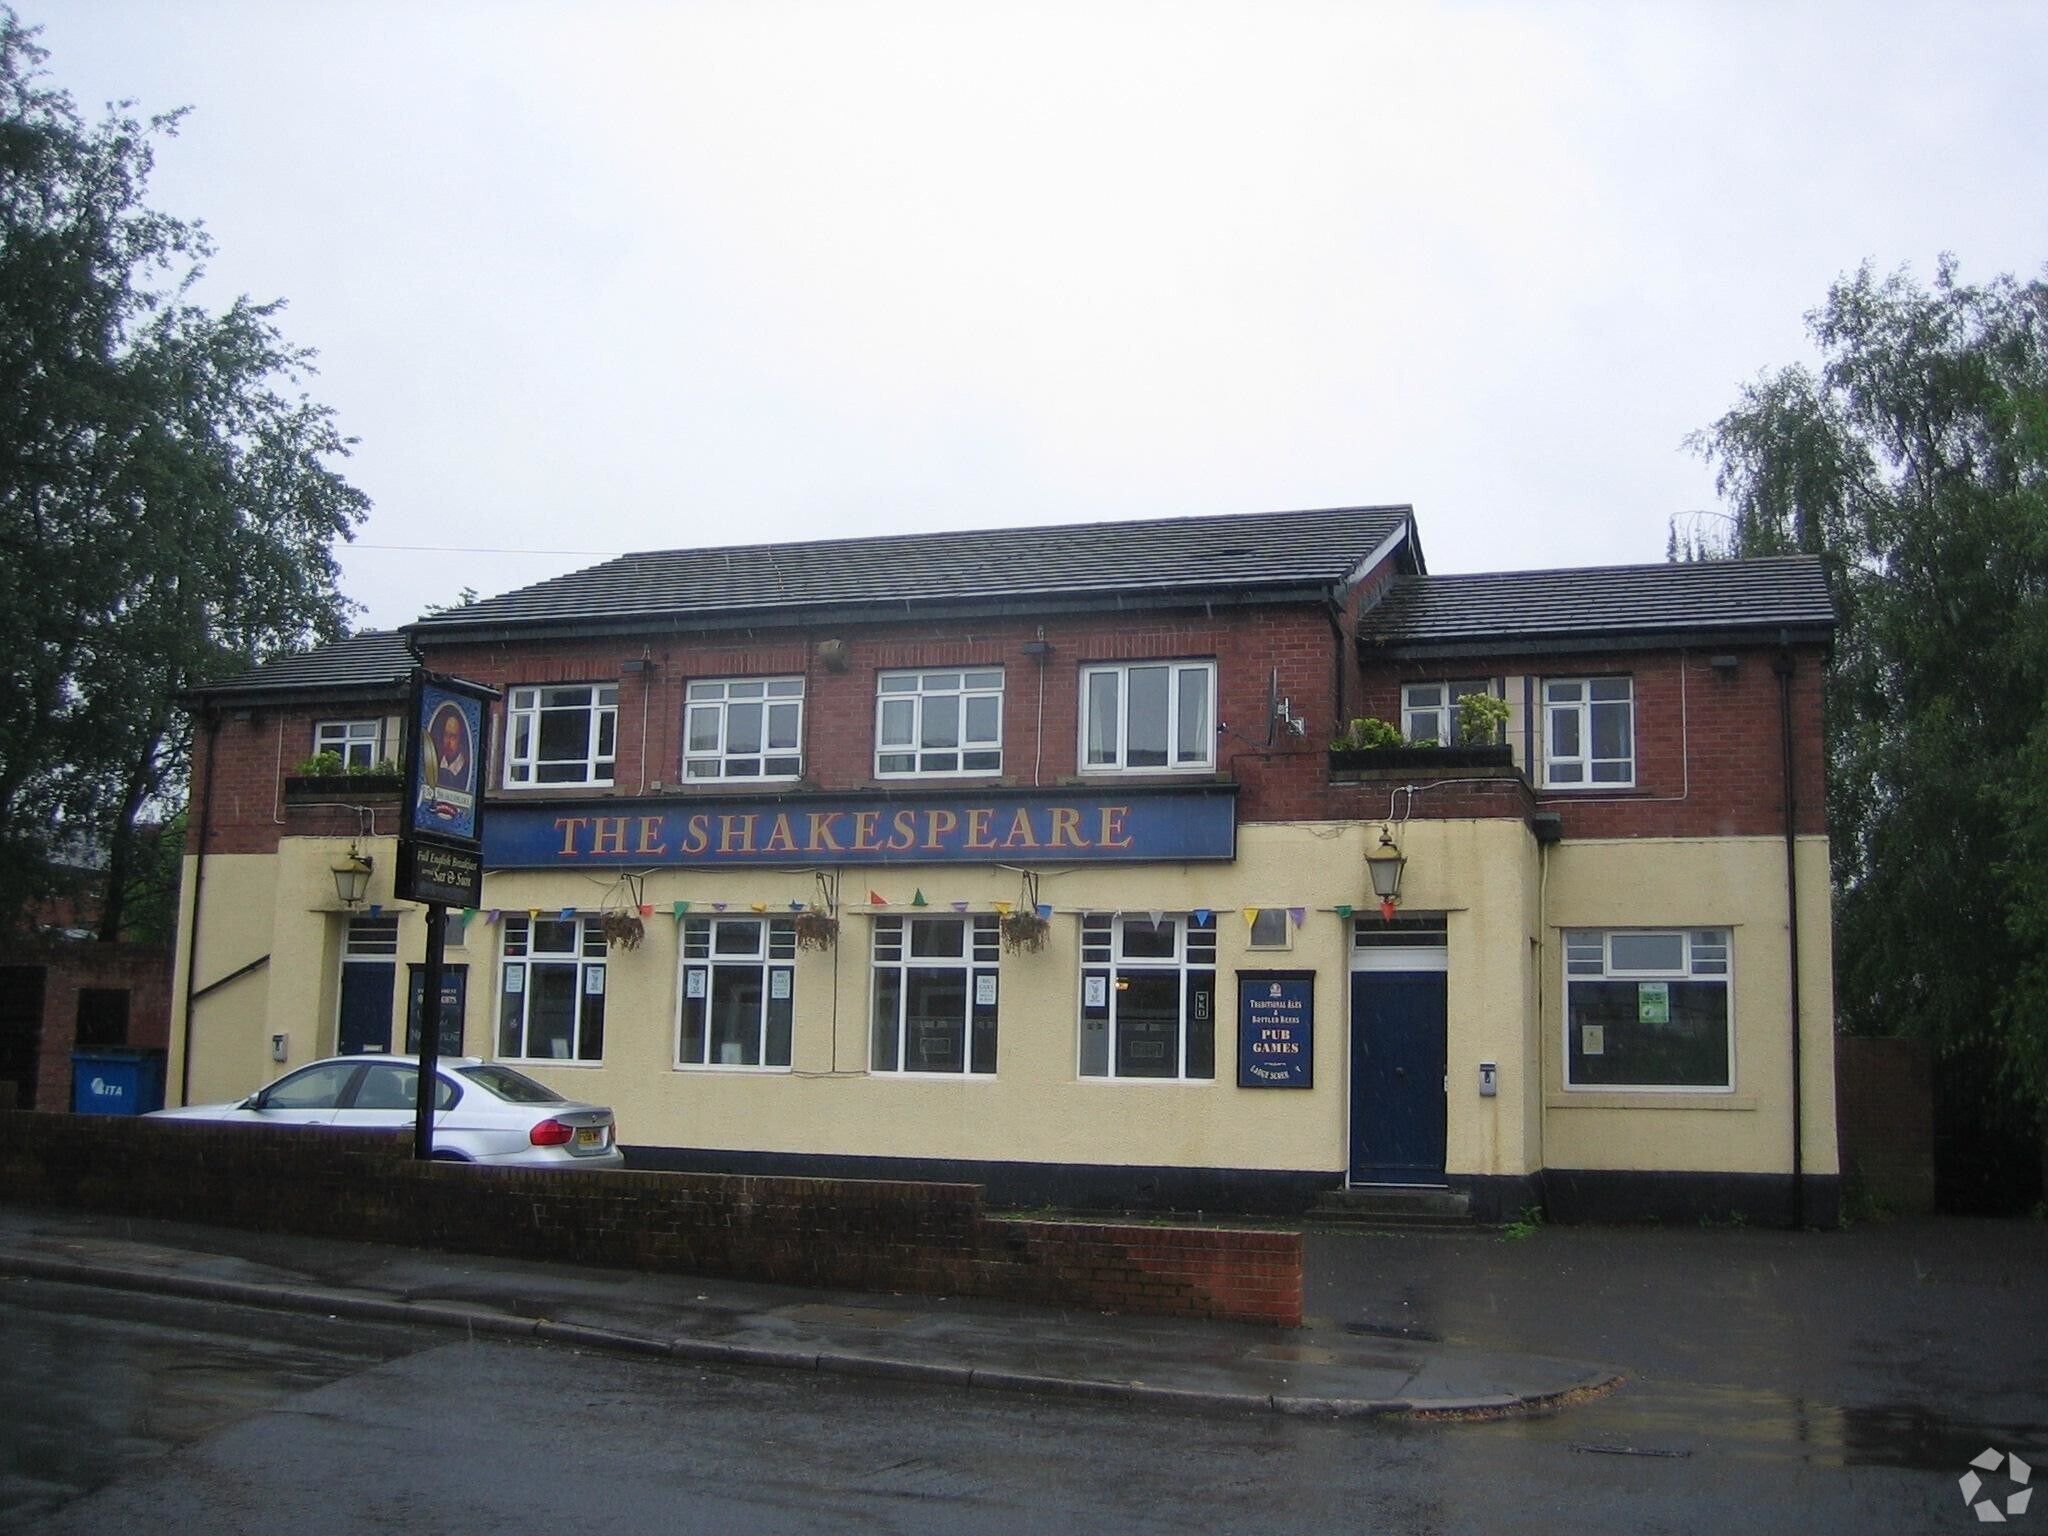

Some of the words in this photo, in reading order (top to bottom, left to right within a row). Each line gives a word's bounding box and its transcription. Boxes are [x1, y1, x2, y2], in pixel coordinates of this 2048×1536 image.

[553, 815, 667, 857] THE
[681, 805, 1133, 856] SHAKESPEARE
[417, 850, 430, 861] Full
[430, 853, 451, 867] English
[447, 870, 455, 884] &
[1261, 1029, 1290, 1040] PUB
[1252, 1042, 1299, 1053] GAMES
